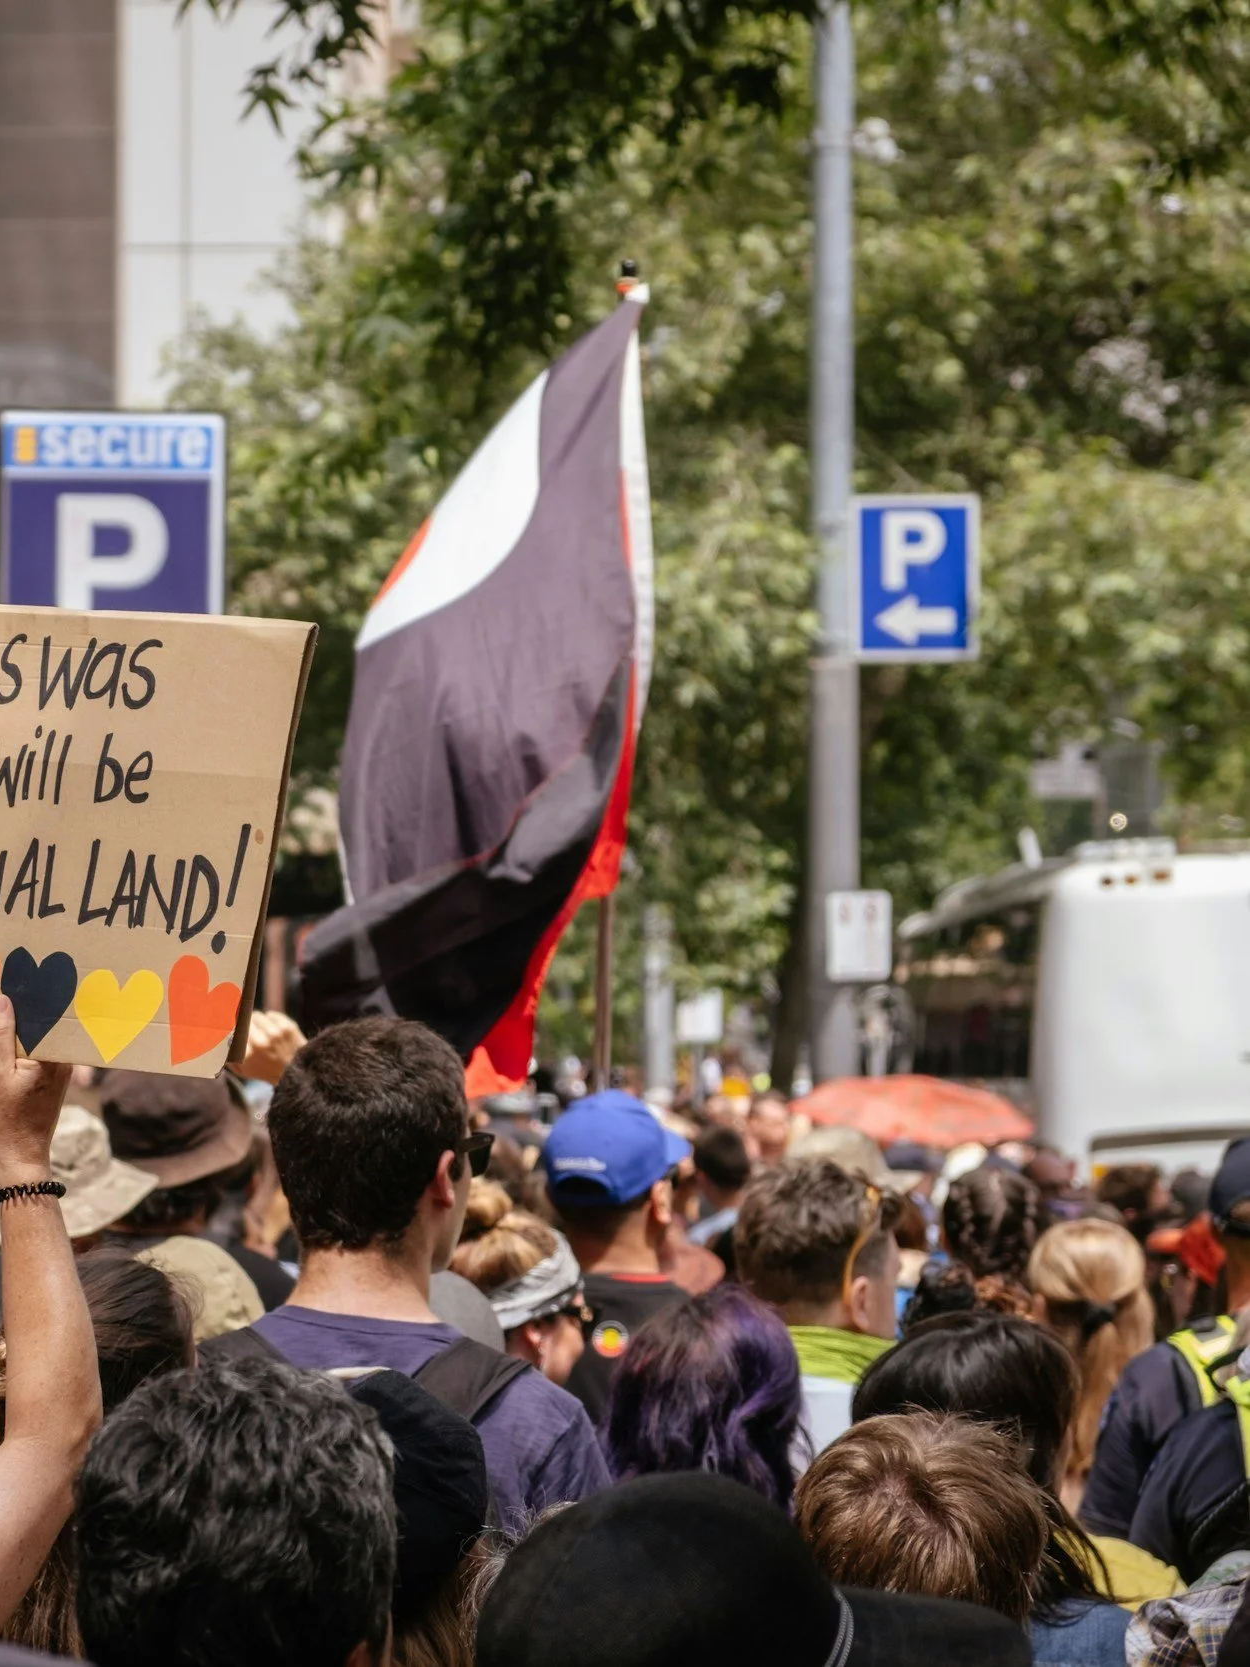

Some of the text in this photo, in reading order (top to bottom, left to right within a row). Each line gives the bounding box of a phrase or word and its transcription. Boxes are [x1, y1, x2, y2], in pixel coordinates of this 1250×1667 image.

[41, 425, 209, 468] secure
[56, 493, 170, 610] P
[881, 510, 948, 592] P
[38, 633, 164, 711] was
[94, 732, 154, 804] be
[77, 823, 252, 955] LAND!
